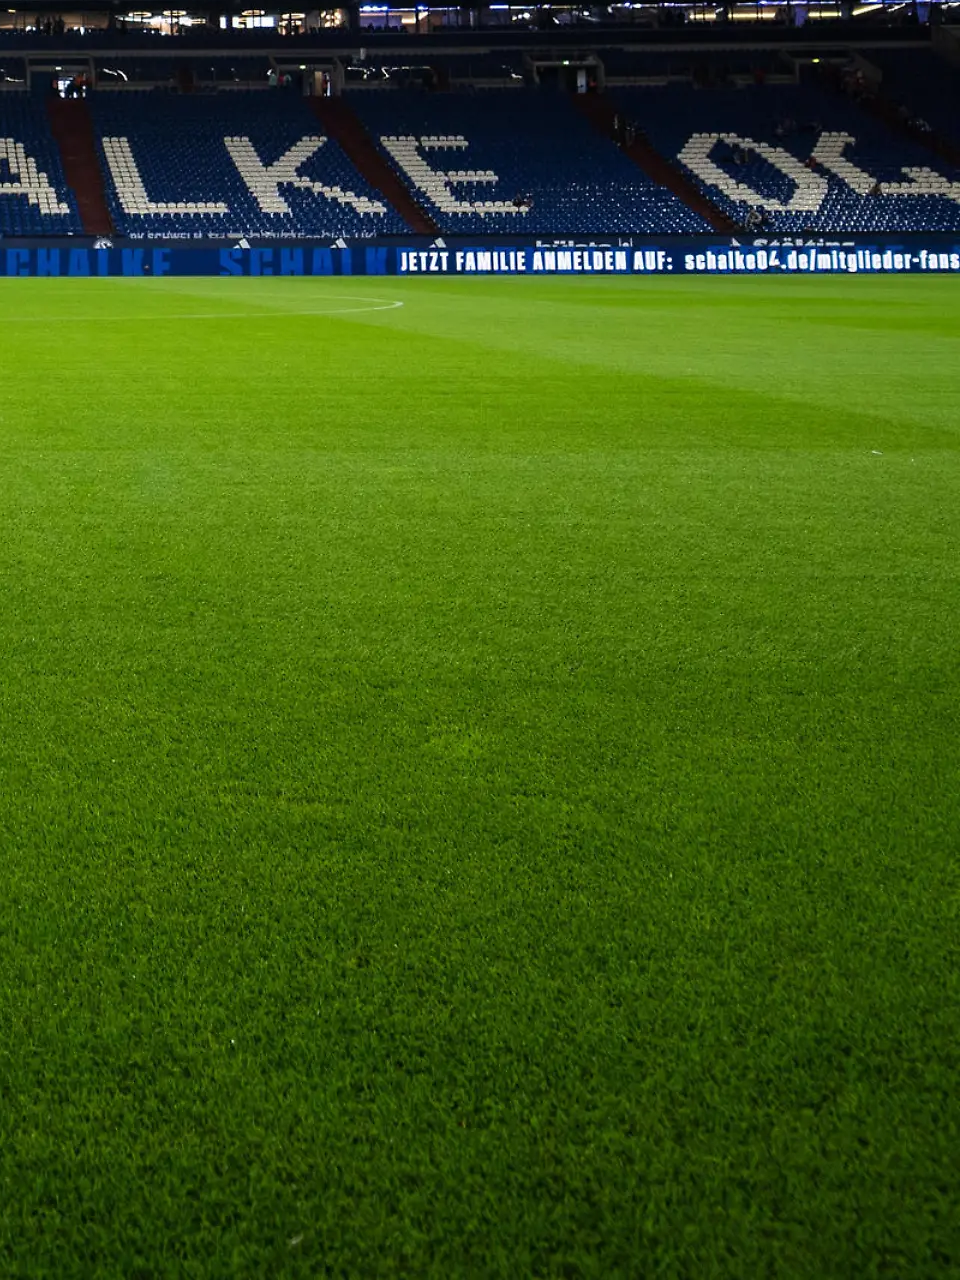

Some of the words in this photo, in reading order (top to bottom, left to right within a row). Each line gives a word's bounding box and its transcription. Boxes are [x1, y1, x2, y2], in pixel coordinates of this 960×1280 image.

[400, 251, 449, 272] JETZT
[455, 251, 526, 271] FAMILIE
[532, 251, 628, 271] ANMELDEN
[633, 251, 673, 271] AUF:
